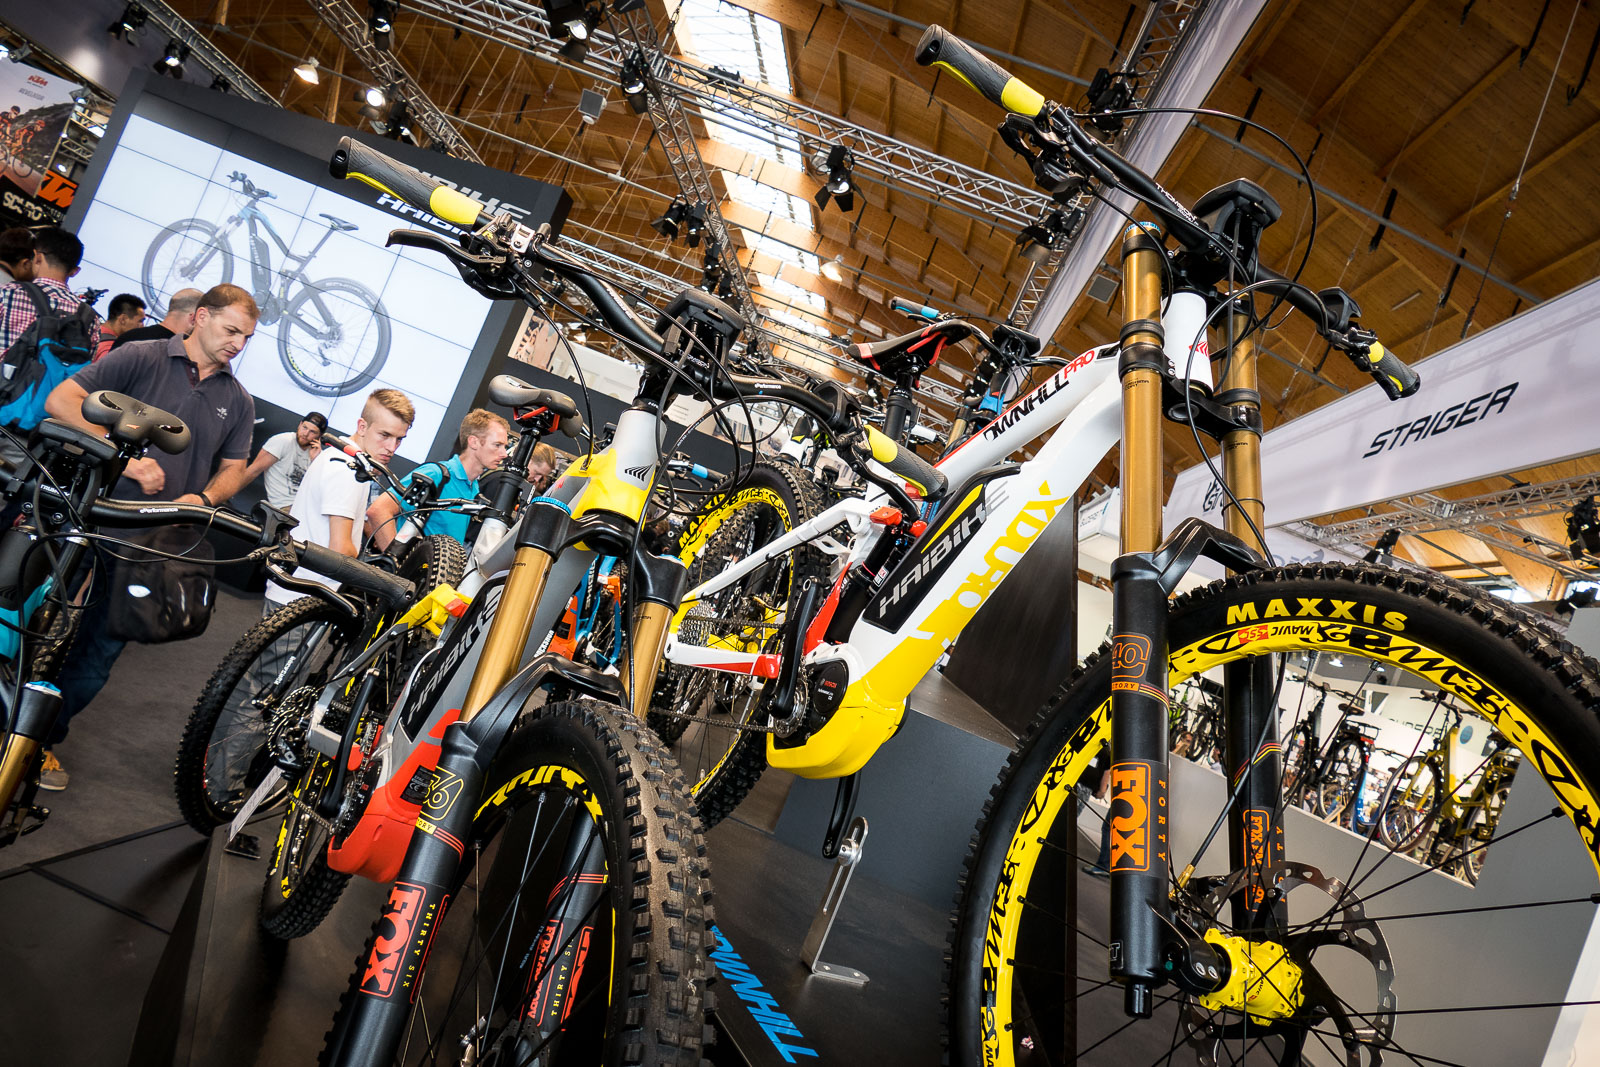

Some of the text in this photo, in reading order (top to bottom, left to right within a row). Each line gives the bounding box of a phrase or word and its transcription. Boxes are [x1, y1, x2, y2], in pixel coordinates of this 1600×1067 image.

[1063, 350, 1095, 380] PRO
[1362, 381, 1519, 459] STAIGER
[1226, 597, 1408, 632] MAXXIS
[1270, 625, 1315, 636] MAVIC
[1111, 766, 1148, 868] FOX
[1157, 779, 1166, 862] FORTY
[361, 889, 422, 992] FOX
[402, 903, 436, 988] THIRTY SIX
[550, 965, 568, 1017] THIRTY
